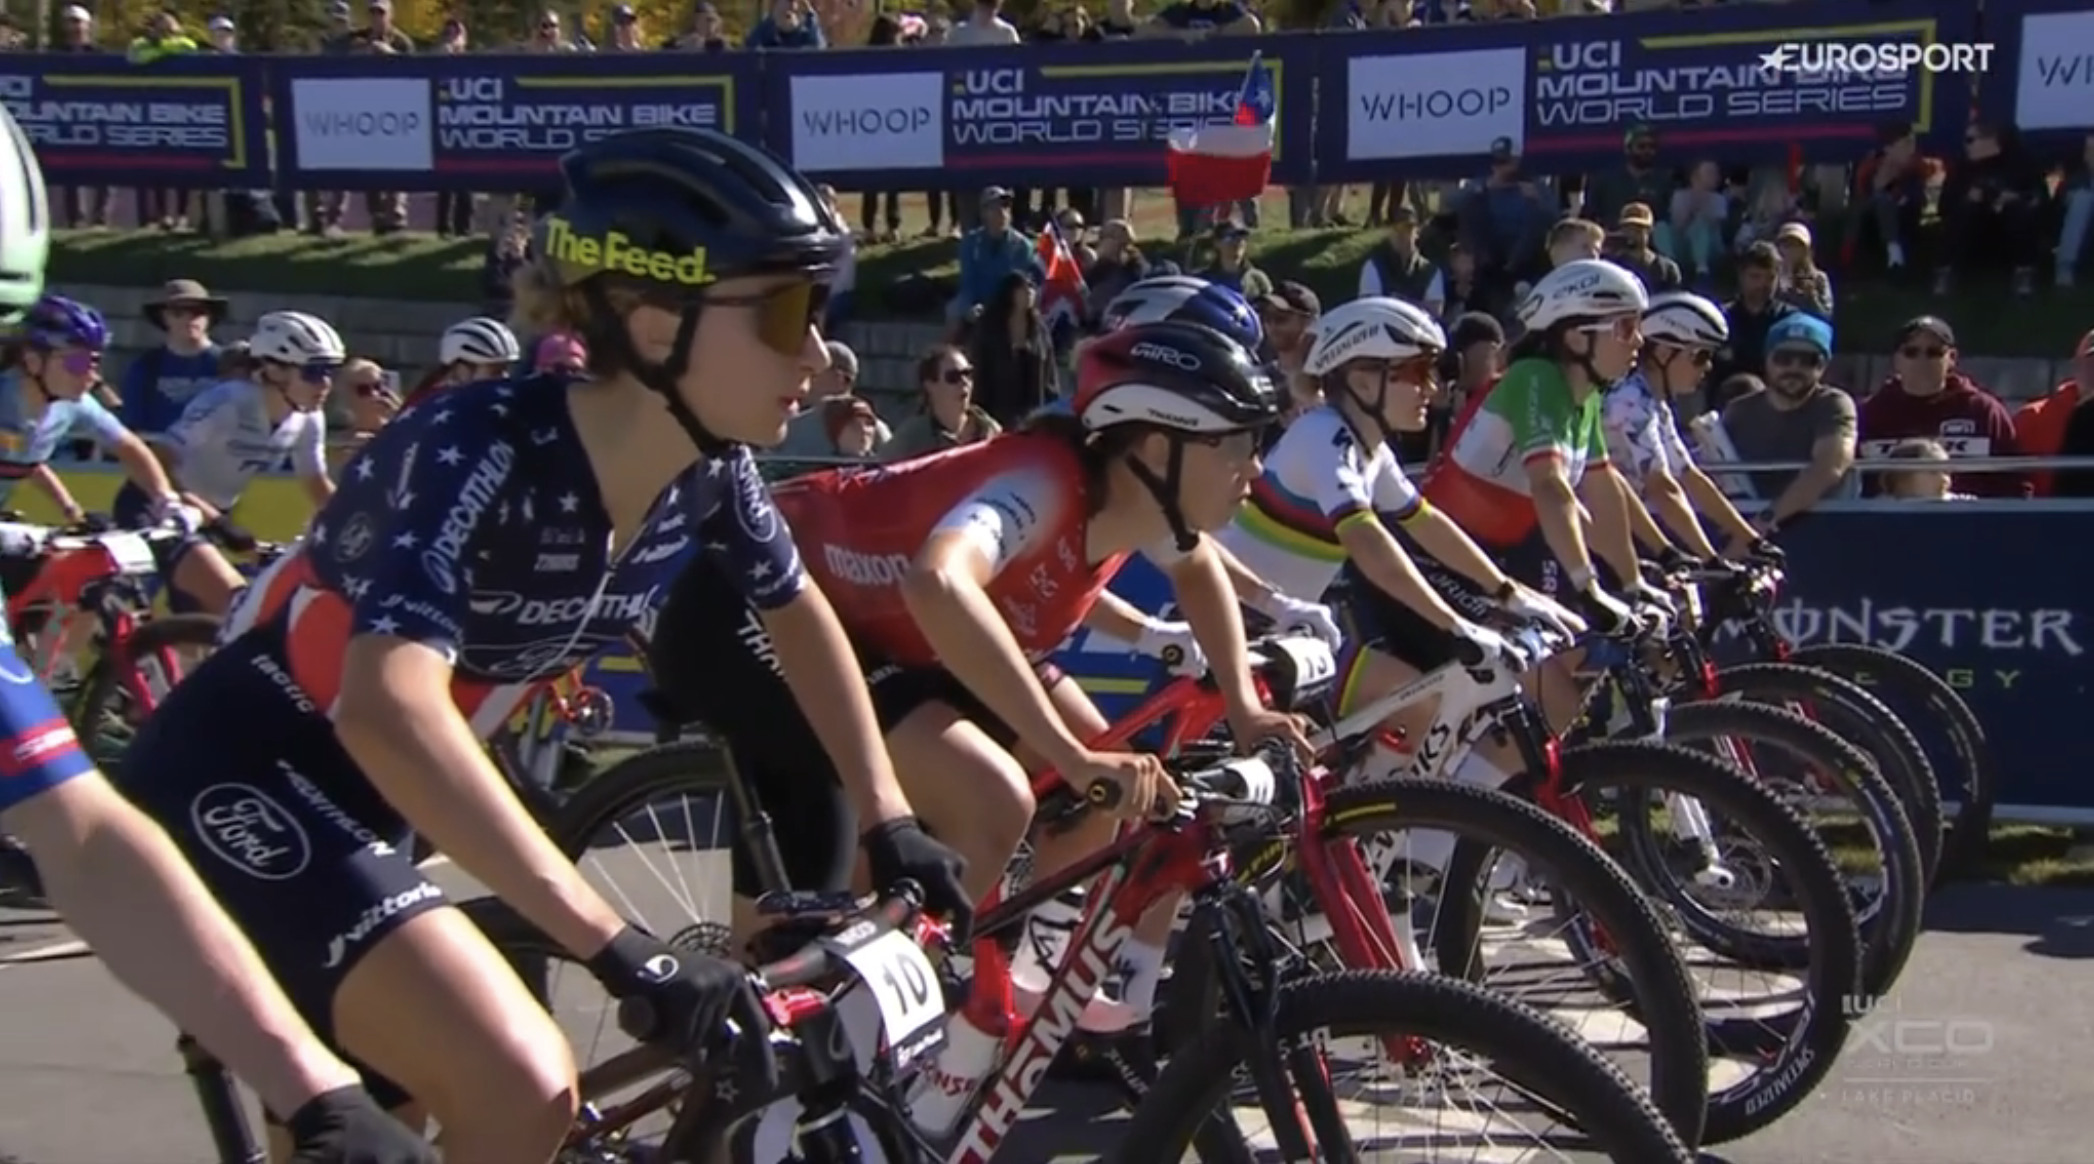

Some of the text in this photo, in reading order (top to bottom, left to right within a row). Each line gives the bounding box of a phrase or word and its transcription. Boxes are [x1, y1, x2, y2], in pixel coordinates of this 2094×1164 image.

[1552, 40, 1620, 70] UCI
[0, 76, 32, 97] CI
[451, 78, 502, 100] UCI
[965, 69, 1024, 94] UCI
[1536, 65, 1781, 98] MOUNTAIN
[5, 101, 225, 124] OUNTAIN BIKE
[439, 104, 716, 124] MOUNTAIN BIKE
[1168, 91, 1239, 113] BIK
[1361, 86, 1511, 122] WHOOP
[1537, 84, 1907, 125] WORLD SERIES
[305, 111, 420, 138] WHOOP
[803, 105, 931, 137] WHOOP
[953, 119, 1100, 144] WORLD
[105, 126, 227, 147] SERIES
[440, 129, 574, 149] WORLD
[546, 216, 717, 284] The Feed.
[1130, 342, 1201, 371] GIRO
[1876, 440, 1969, 455] TK
[823, 542, 910, 587] maxon
[203, 798, 291, 869] Ford
[882, 953, 929, 1016] 10
